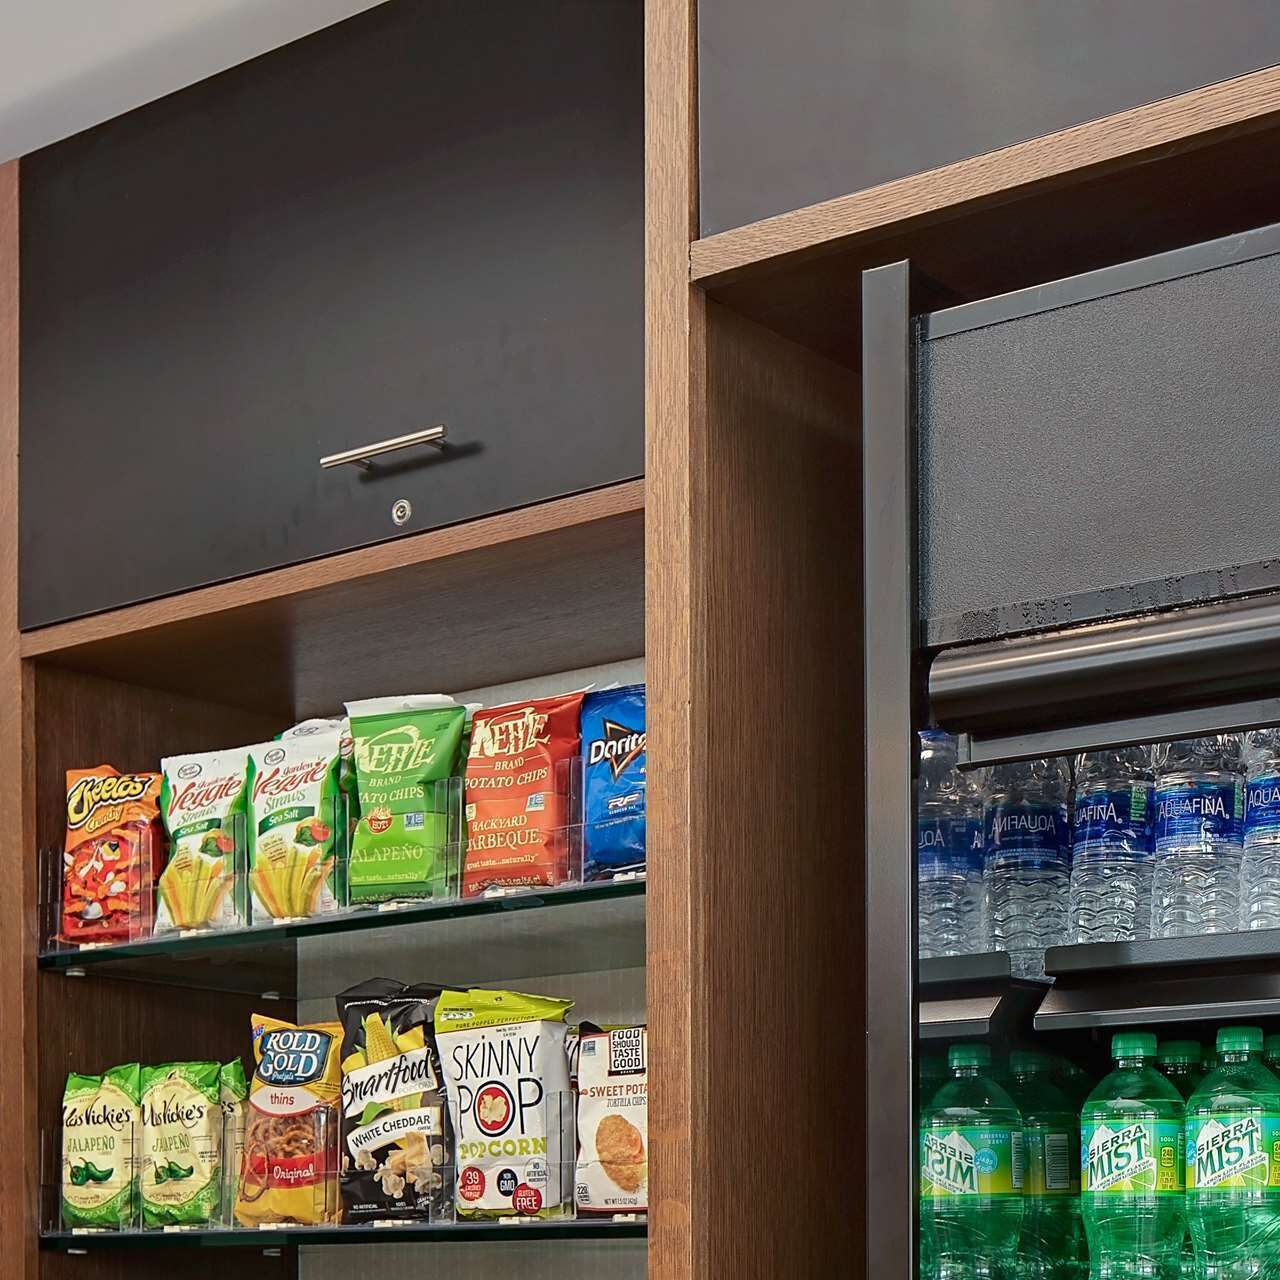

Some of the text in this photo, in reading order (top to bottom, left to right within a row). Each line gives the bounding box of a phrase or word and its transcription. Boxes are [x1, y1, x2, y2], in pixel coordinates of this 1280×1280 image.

[470, 706, 551, 759] KETTLE
[354, 725, 436, 774] KETTLE
[494, 757, 525, 771] BRAND
[253, 762, 328, 803] Veggie
[368, 775, 402, 788] BRAND
[517, 767, 548, 785] CHIPS
[68, 775, 154, 826] Cheetos
[169, 776, 242, 817] Veggie
[389, 786, 424, 801] CHIPS
[86, 807, 123, 833] Crunchy
[1159, 797, 1225, 822] AQUAFINA
[472, 815, 528, 832] BACKYARD
[266, 1032, 320, 1052] ROLD
[612, 1029, 640, 1040] FOOD
[612, 1039, 640, 1050] SHOULD
[260, 1052, 319, 1077] GOLD
[452, 1035, 540, 1081] SKINNY
[612, 1048, 640, 1058] TASTE
[613, 1057, 640, 1069] GOOD
[342, 1050, 431, 1111] Smartfood
[589, 1085, 623, 1098] SWEET
[269, 1093, 295, 1106] thins
[457, 1078, 543, 1139] POP
[352, 1115, 431, 1148] WHITE CHEDDAR
[1089, 1125, 1144, 1160] SIERRA
[1197, 1118, 1256, 1156] SIERRA
[68, 1135, 115, 1152] JALAPEÑO
[459, 1137, 547, 1160] POPCORN
[1088, 1134, 1147, 1188] MIST
[1196, 1129, 1259, 1182] MIST
[273, 1165, 315, 1182] Original
[466, 1172, 480, 1184] 39
[516, 1196, 538, 1210] FREE
